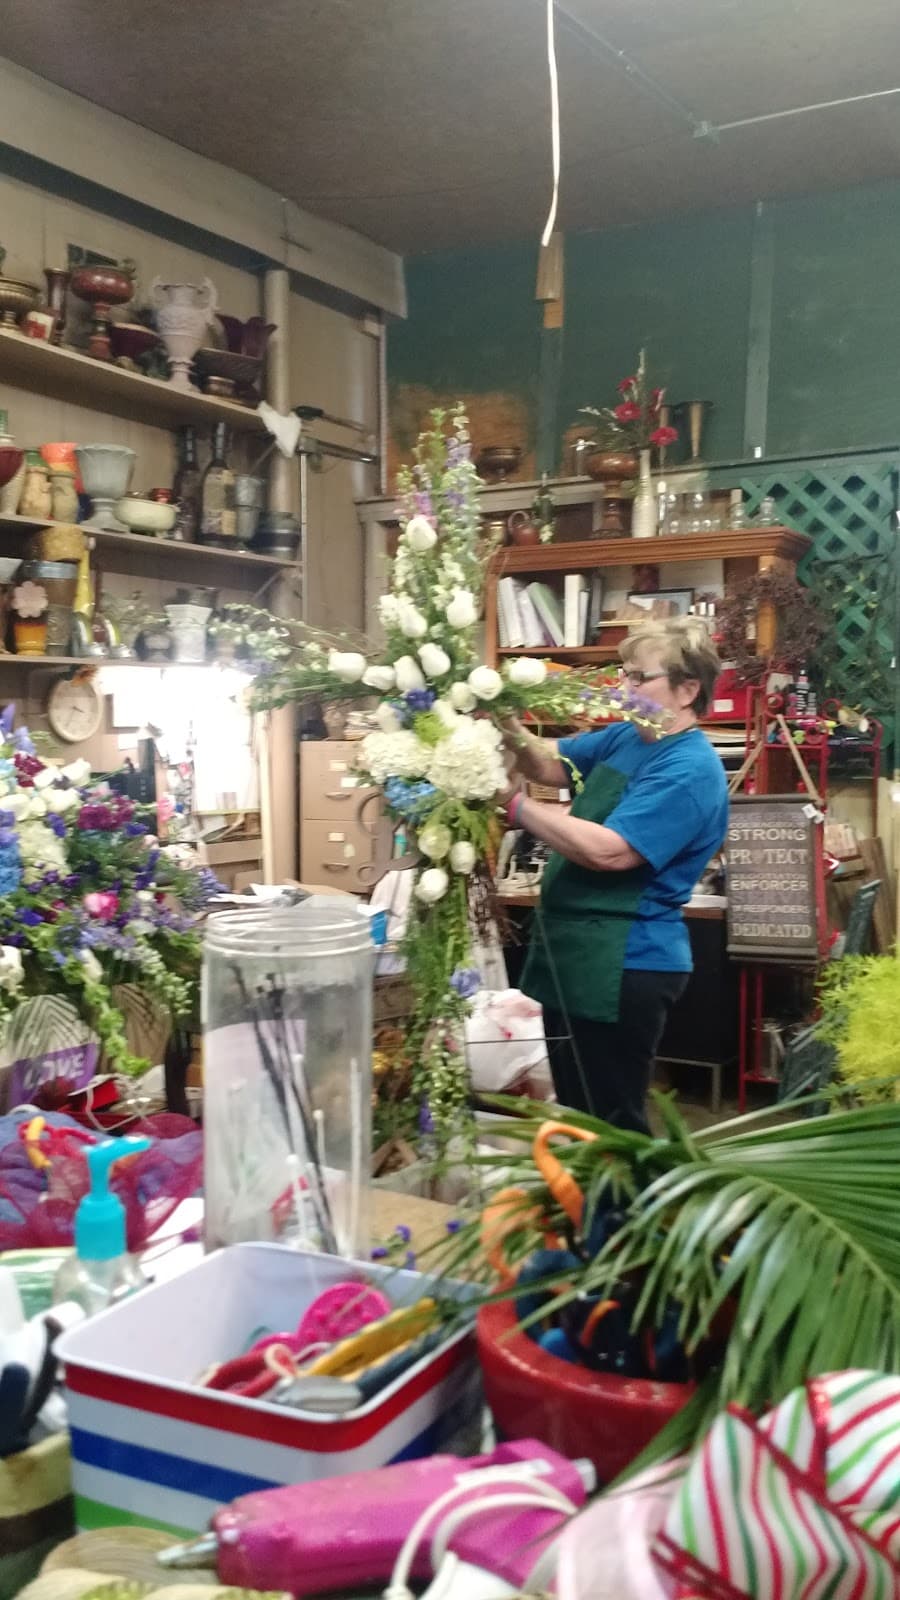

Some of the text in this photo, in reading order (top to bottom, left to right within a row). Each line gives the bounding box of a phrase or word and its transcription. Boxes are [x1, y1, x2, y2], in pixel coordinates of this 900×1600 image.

[728, 828, 807, 841] STRONG
[730, 880, 809, 891] ENFORCER
[732, 922, 812, 938] DEDICATED
